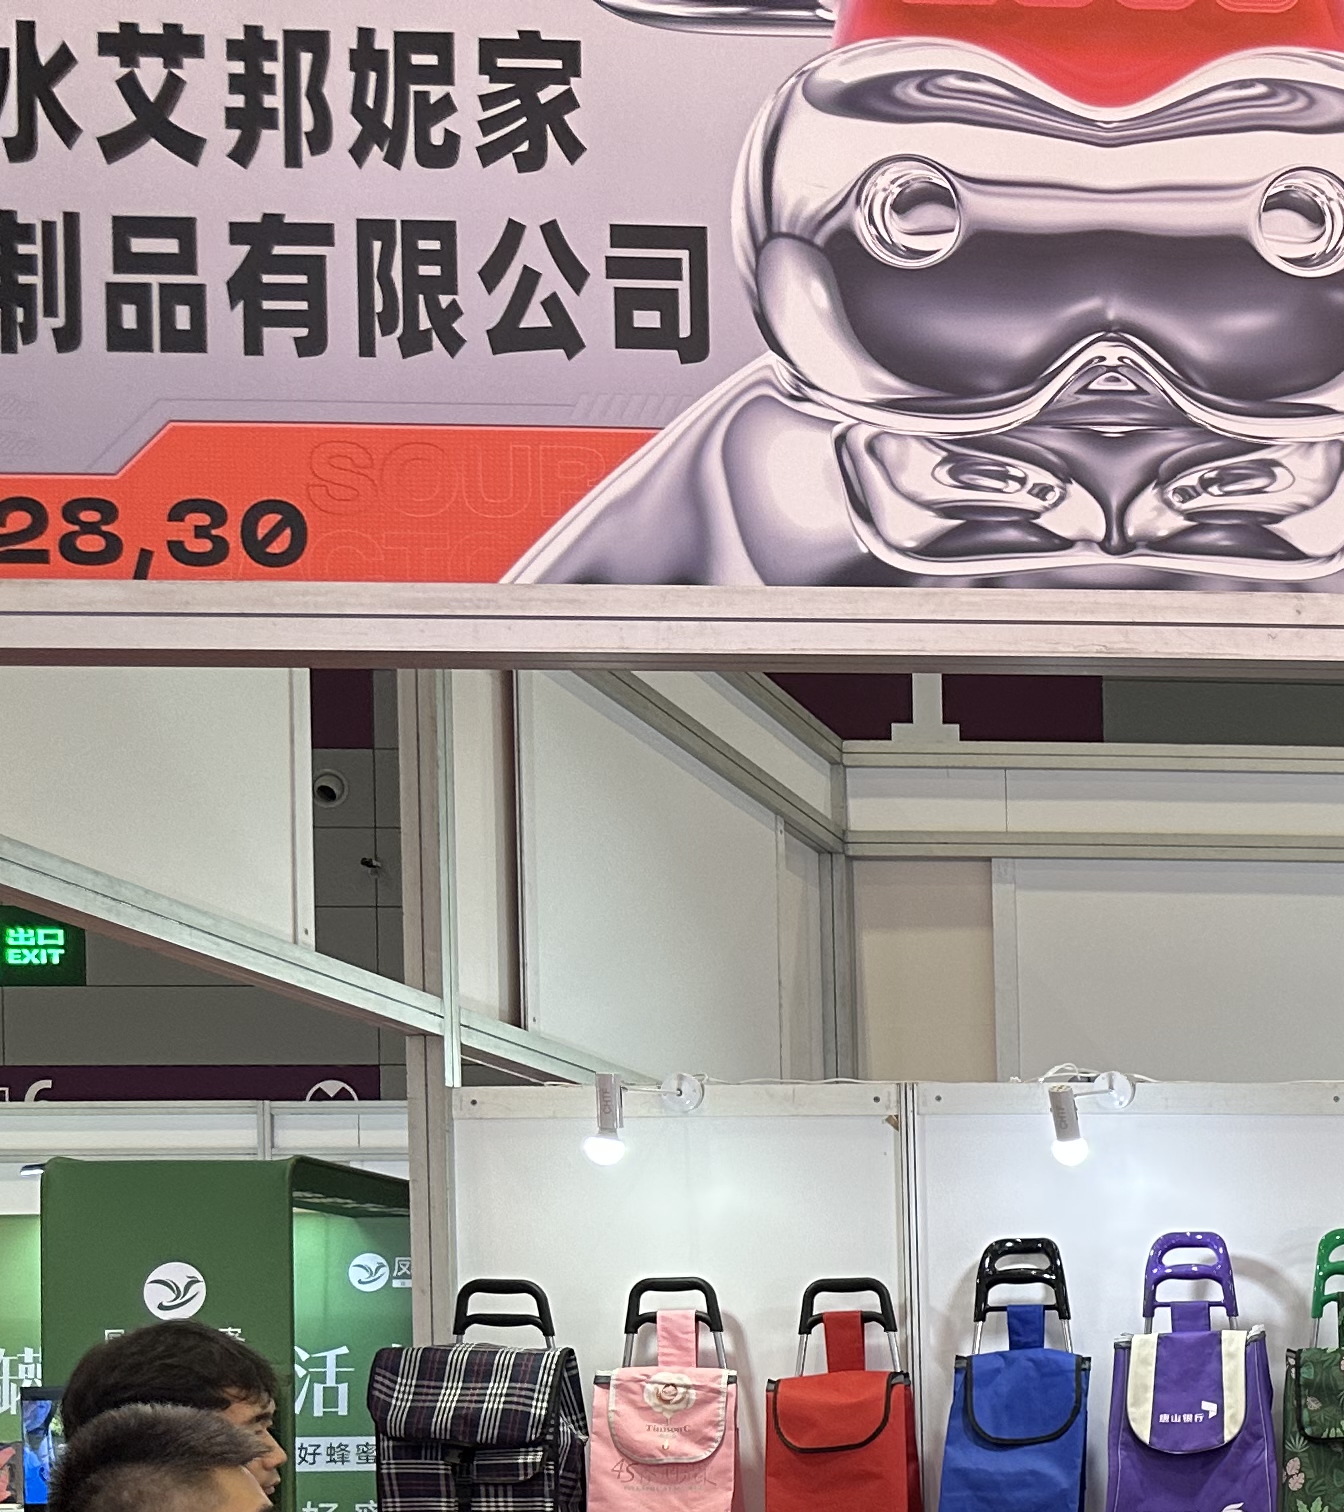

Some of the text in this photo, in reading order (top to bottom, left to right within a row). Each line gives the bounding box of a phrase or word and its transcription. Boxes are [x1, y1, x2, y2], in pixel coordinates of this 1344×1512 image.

[0, 20, 587, 174] 水艾邦妮家
[0, 209, 711, 365] 制品有限公司
[6, 927, 65, 946] 出口
[7, 948, 65, 965] EXIT
[295, 1346, 354, 1416] 活
[1159, 1413, 1204, 1423] 唐山银行
